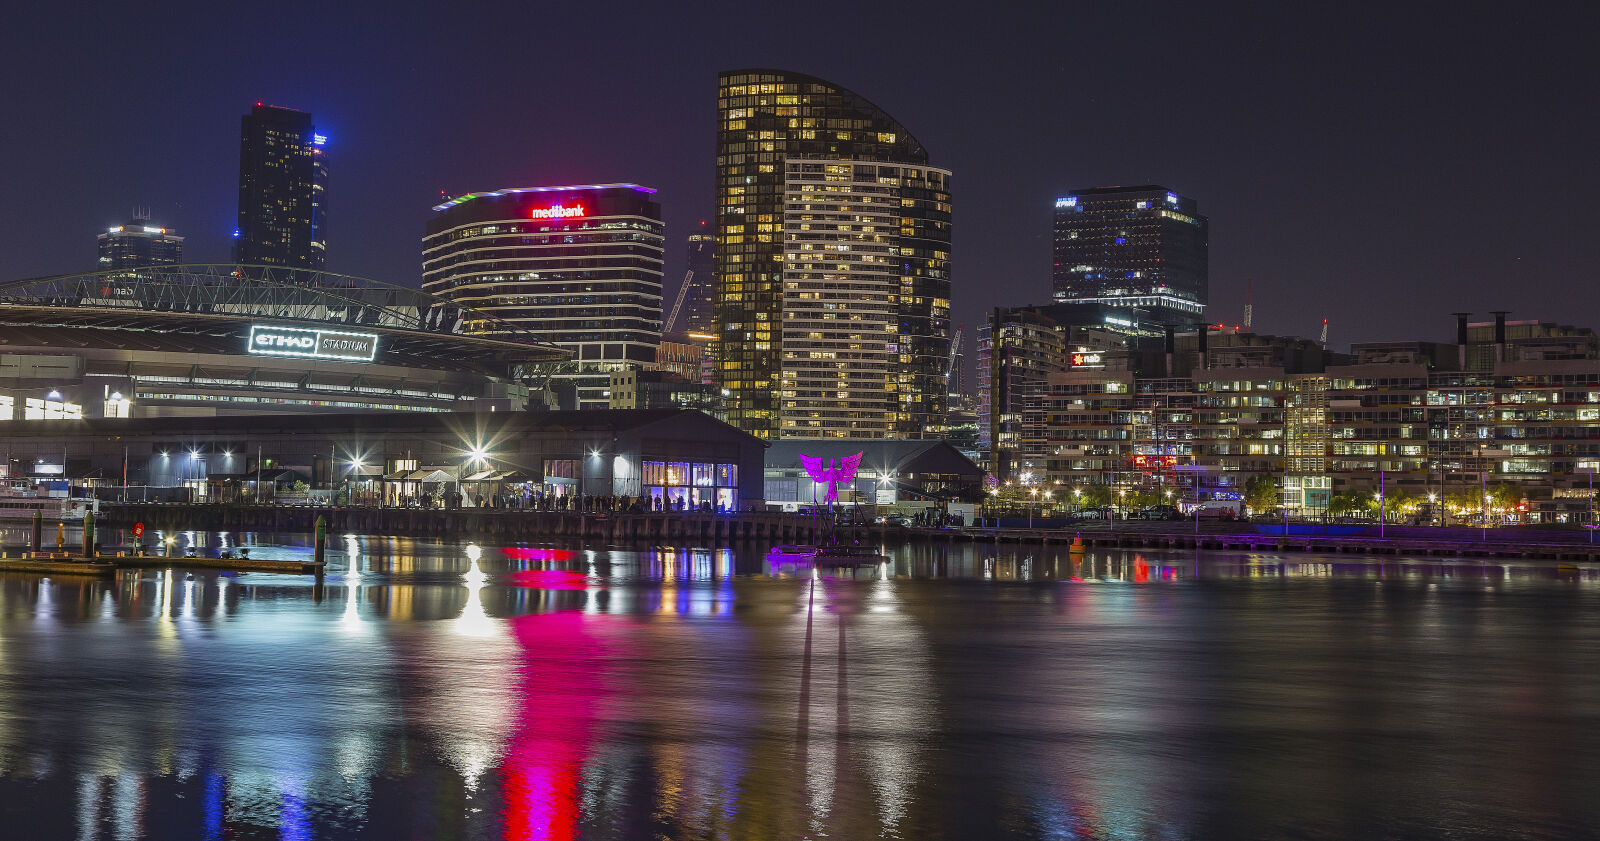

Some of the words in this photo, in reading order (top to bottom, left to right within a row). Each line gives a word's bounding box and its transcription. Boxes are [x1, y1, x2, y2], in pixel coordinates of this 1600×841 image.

[532, 204, 584, 218] medibank
[113, 286, 133, 295] nab
[255, 335, 315, 348] ETIHAD
[322, 338, 369, 352] STADIUM
[1083, 353, 1101, 363] nab
